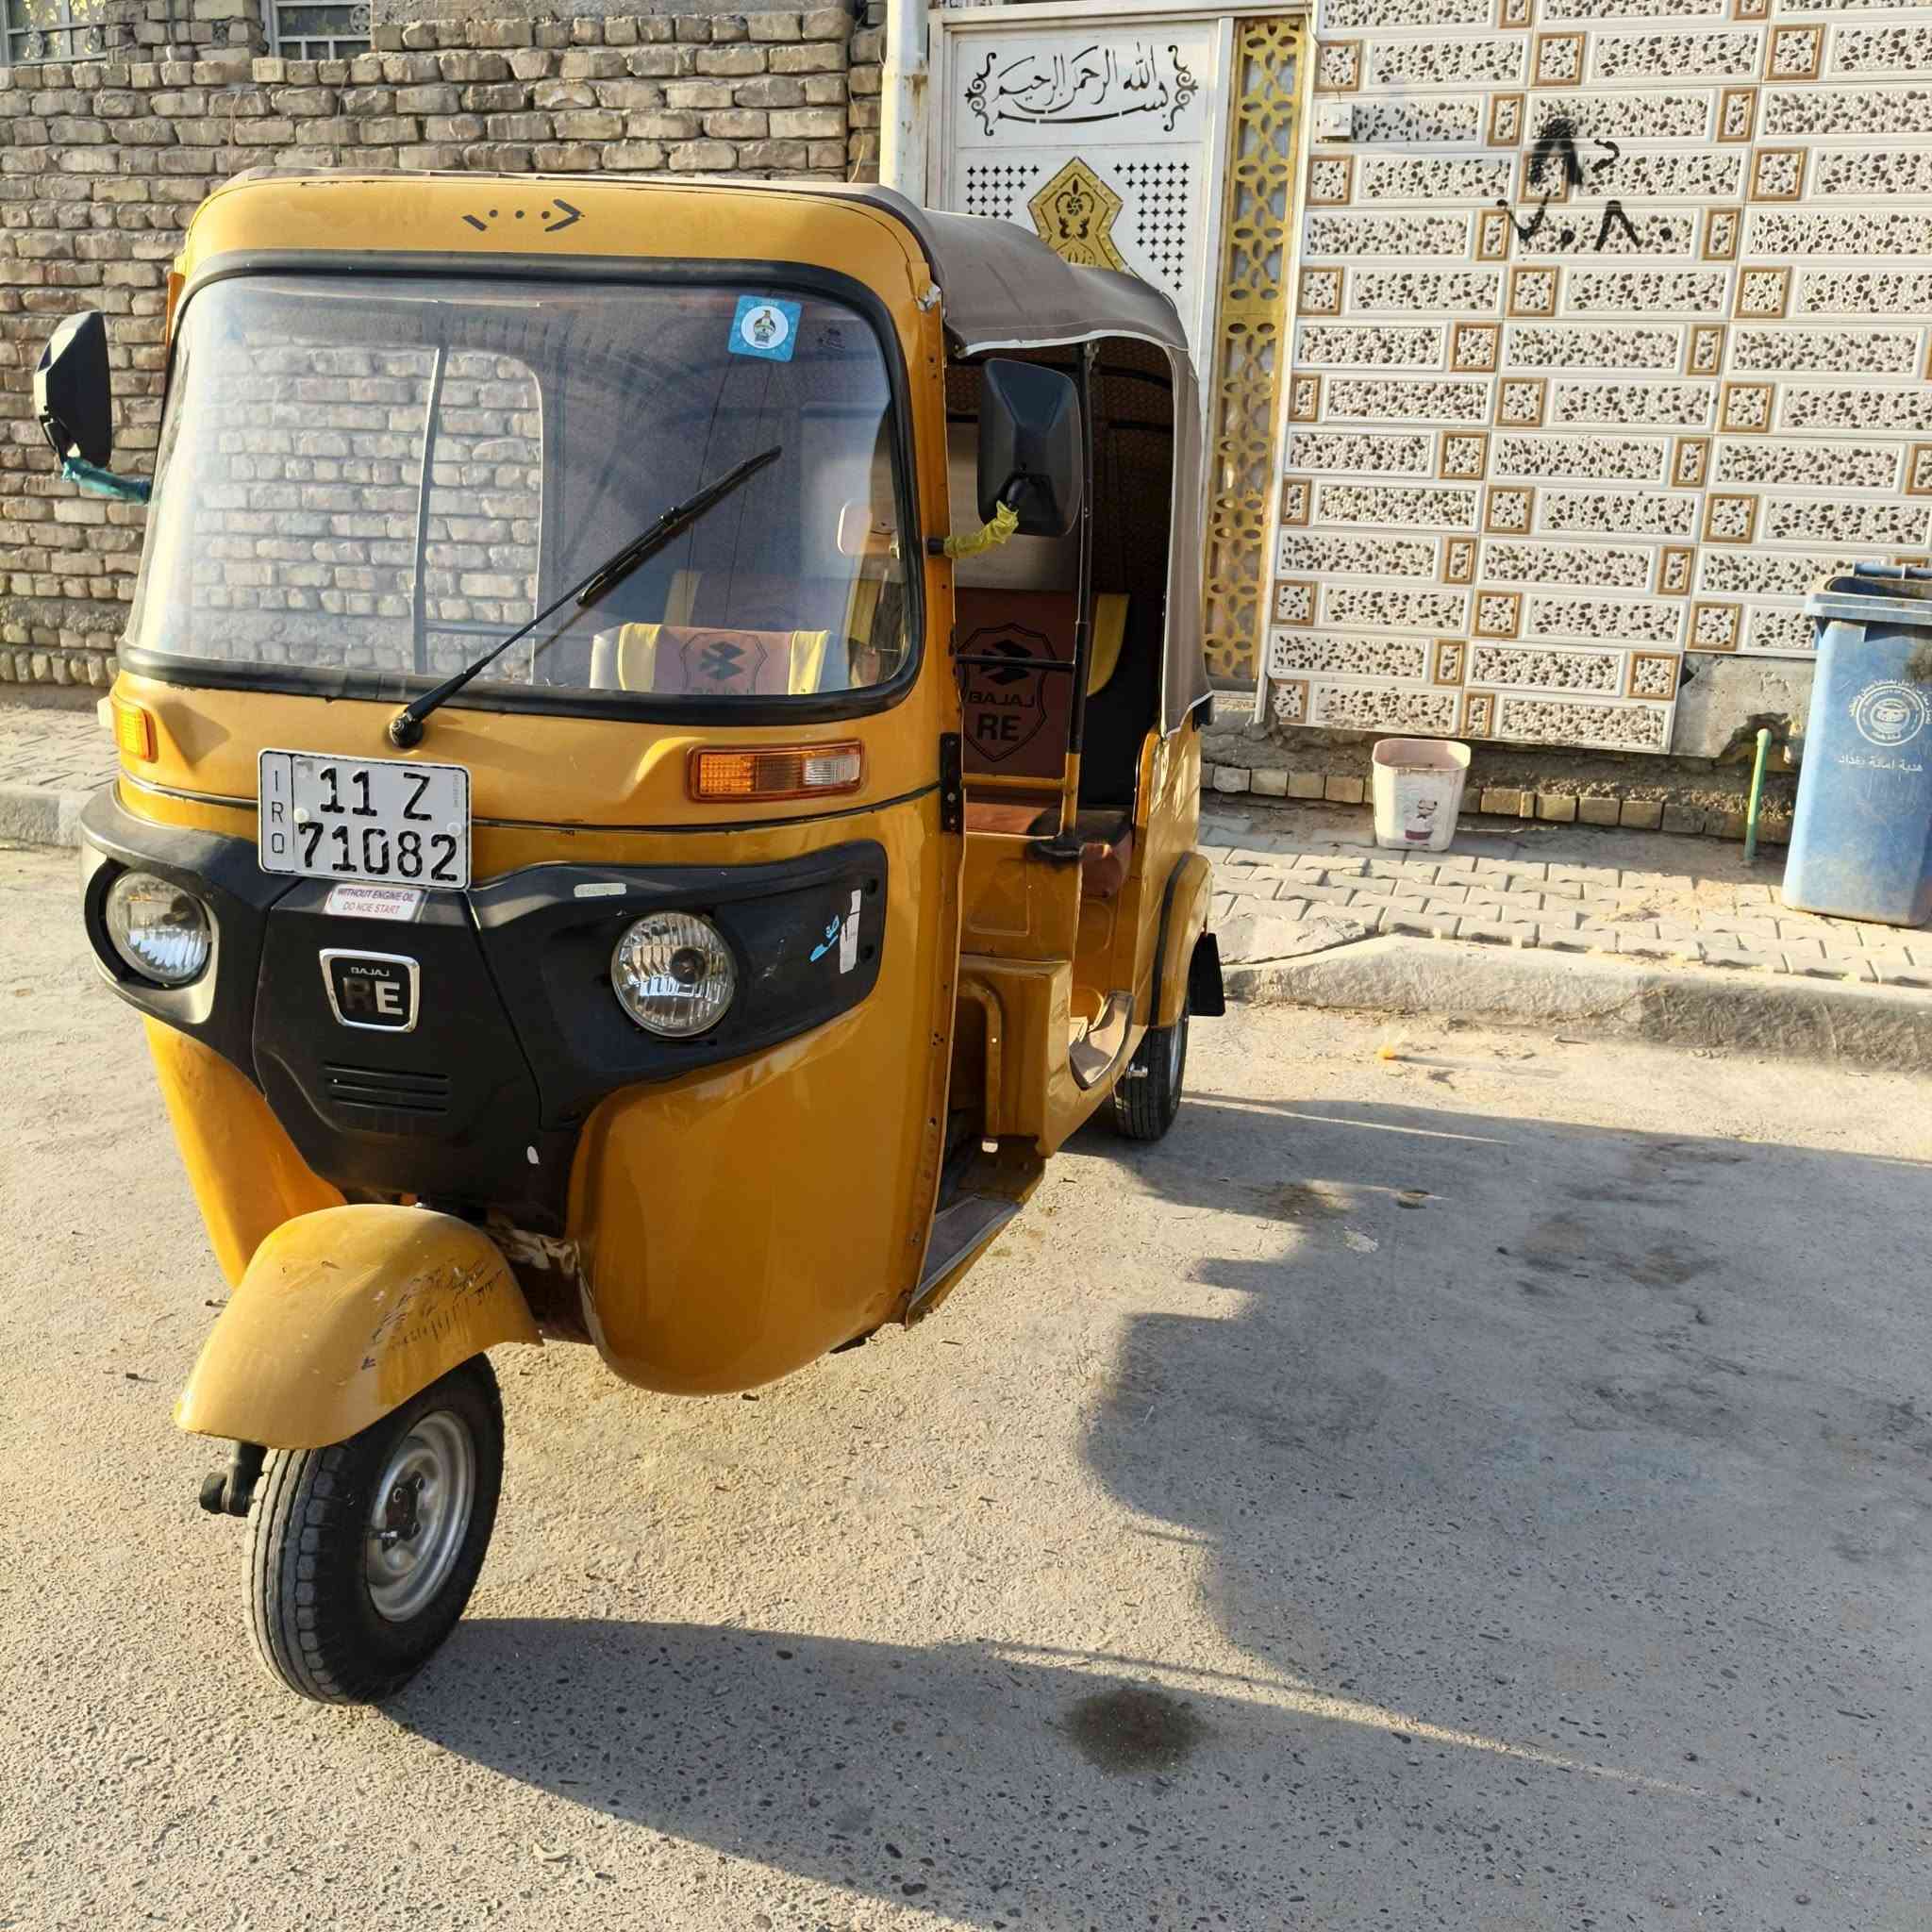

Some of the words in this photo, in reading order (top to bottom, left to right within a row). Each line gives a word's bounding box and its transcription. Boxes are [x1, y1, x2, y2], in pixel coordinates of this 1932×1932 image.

[967, 691, 1036, 708] BAJAJ
[976, 711, 1022, 741] RE
[319, 767, 378, 817] 11
[402, 772, 433, 822] Z
[297, 821, 458, 882] 71082
[342, 899, 356, 911] DO
[374, 903, 401, 914] START
[372, 889, 403, 901] ENGINE
